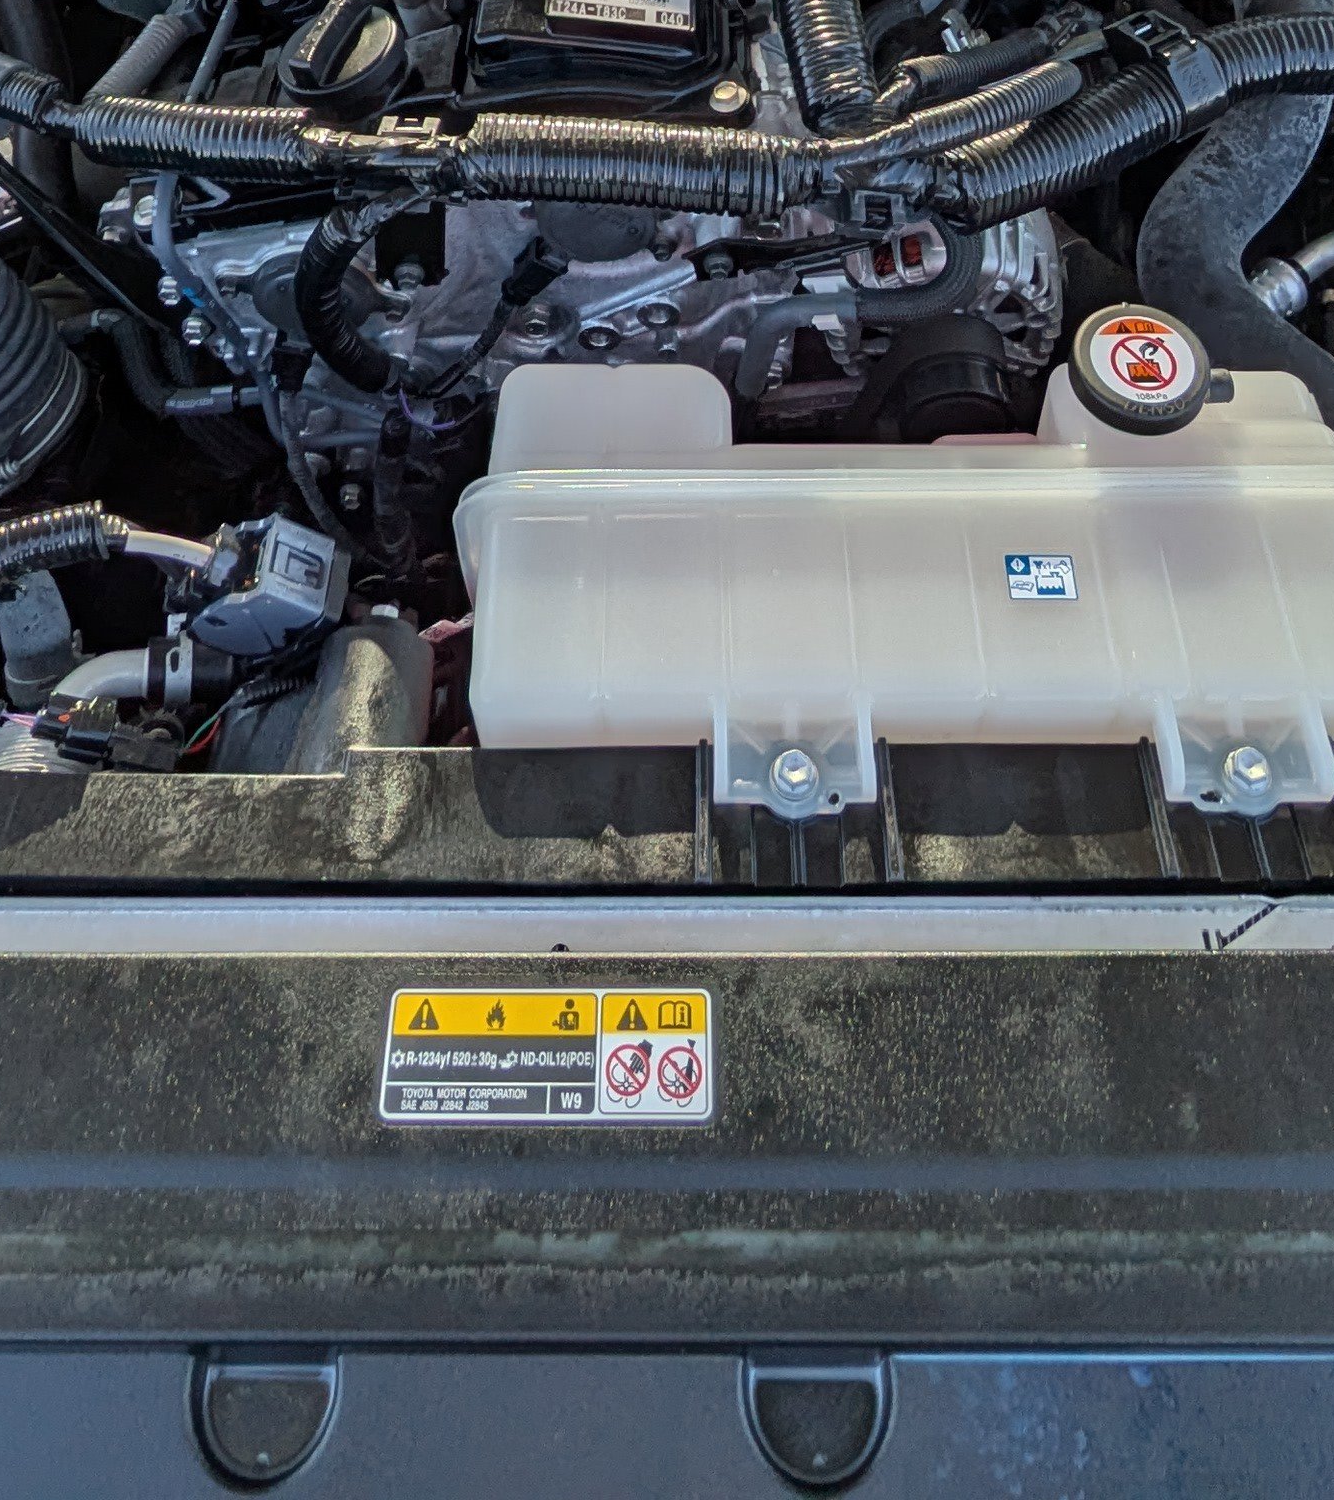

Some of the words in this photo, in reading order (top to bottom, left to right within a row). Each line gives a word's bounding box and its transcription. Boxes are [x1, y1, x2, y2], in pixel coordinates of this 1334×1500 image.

[406, 1050, 450, 1069] R-1234yf
[452, 1051, 498, 1069] 520±30g
[520, 1051, 595, 1068] ND-OIL12(POE)
[402, 1087, 434, 1098] TOYOTA
[436, 1087, 466, 1099] MOTOR
[468, 1087, 528, 1099] CORPORATION
[400, 1100, 417, 1111] SAE
[560, 1092, 582, 1109] W9
